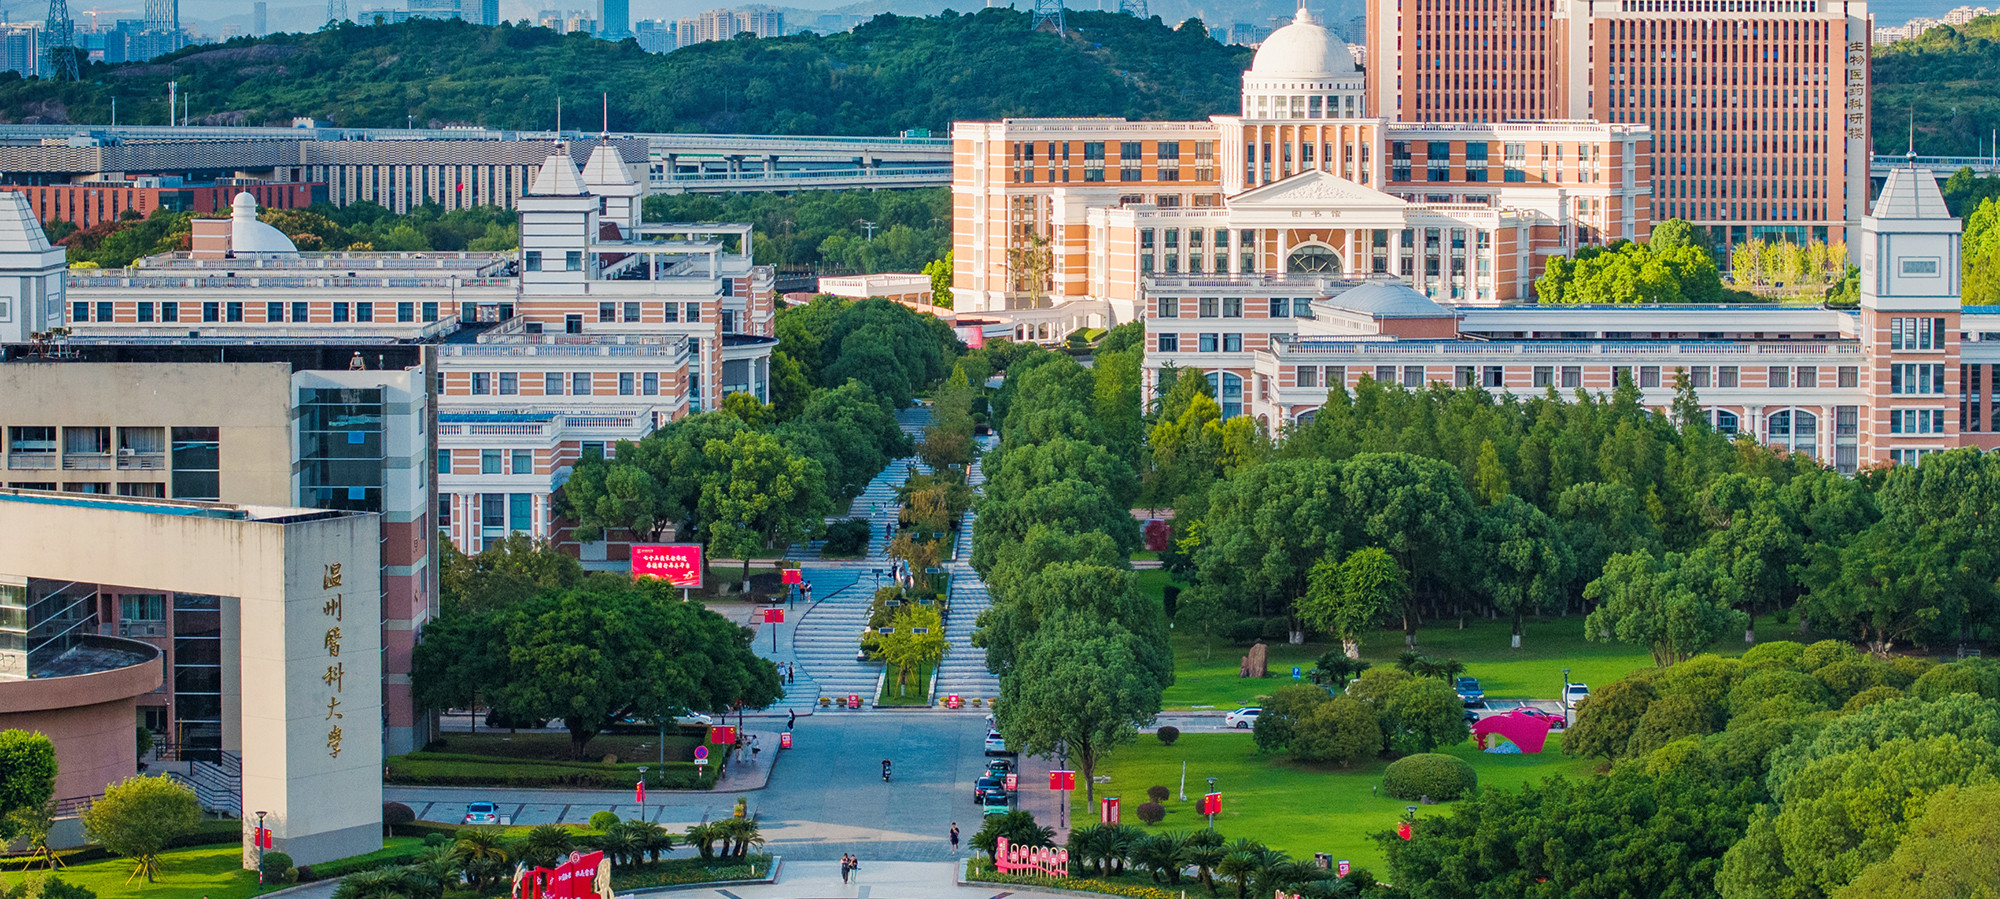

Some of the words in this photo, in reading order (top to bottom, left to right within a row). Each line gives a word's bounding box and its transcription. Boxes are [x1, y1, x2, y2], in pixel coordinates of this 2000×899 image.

[1849, 41, 1865, 140] 生物医药科研楼
[322, 561, 345, 759] 温州醫科大學
